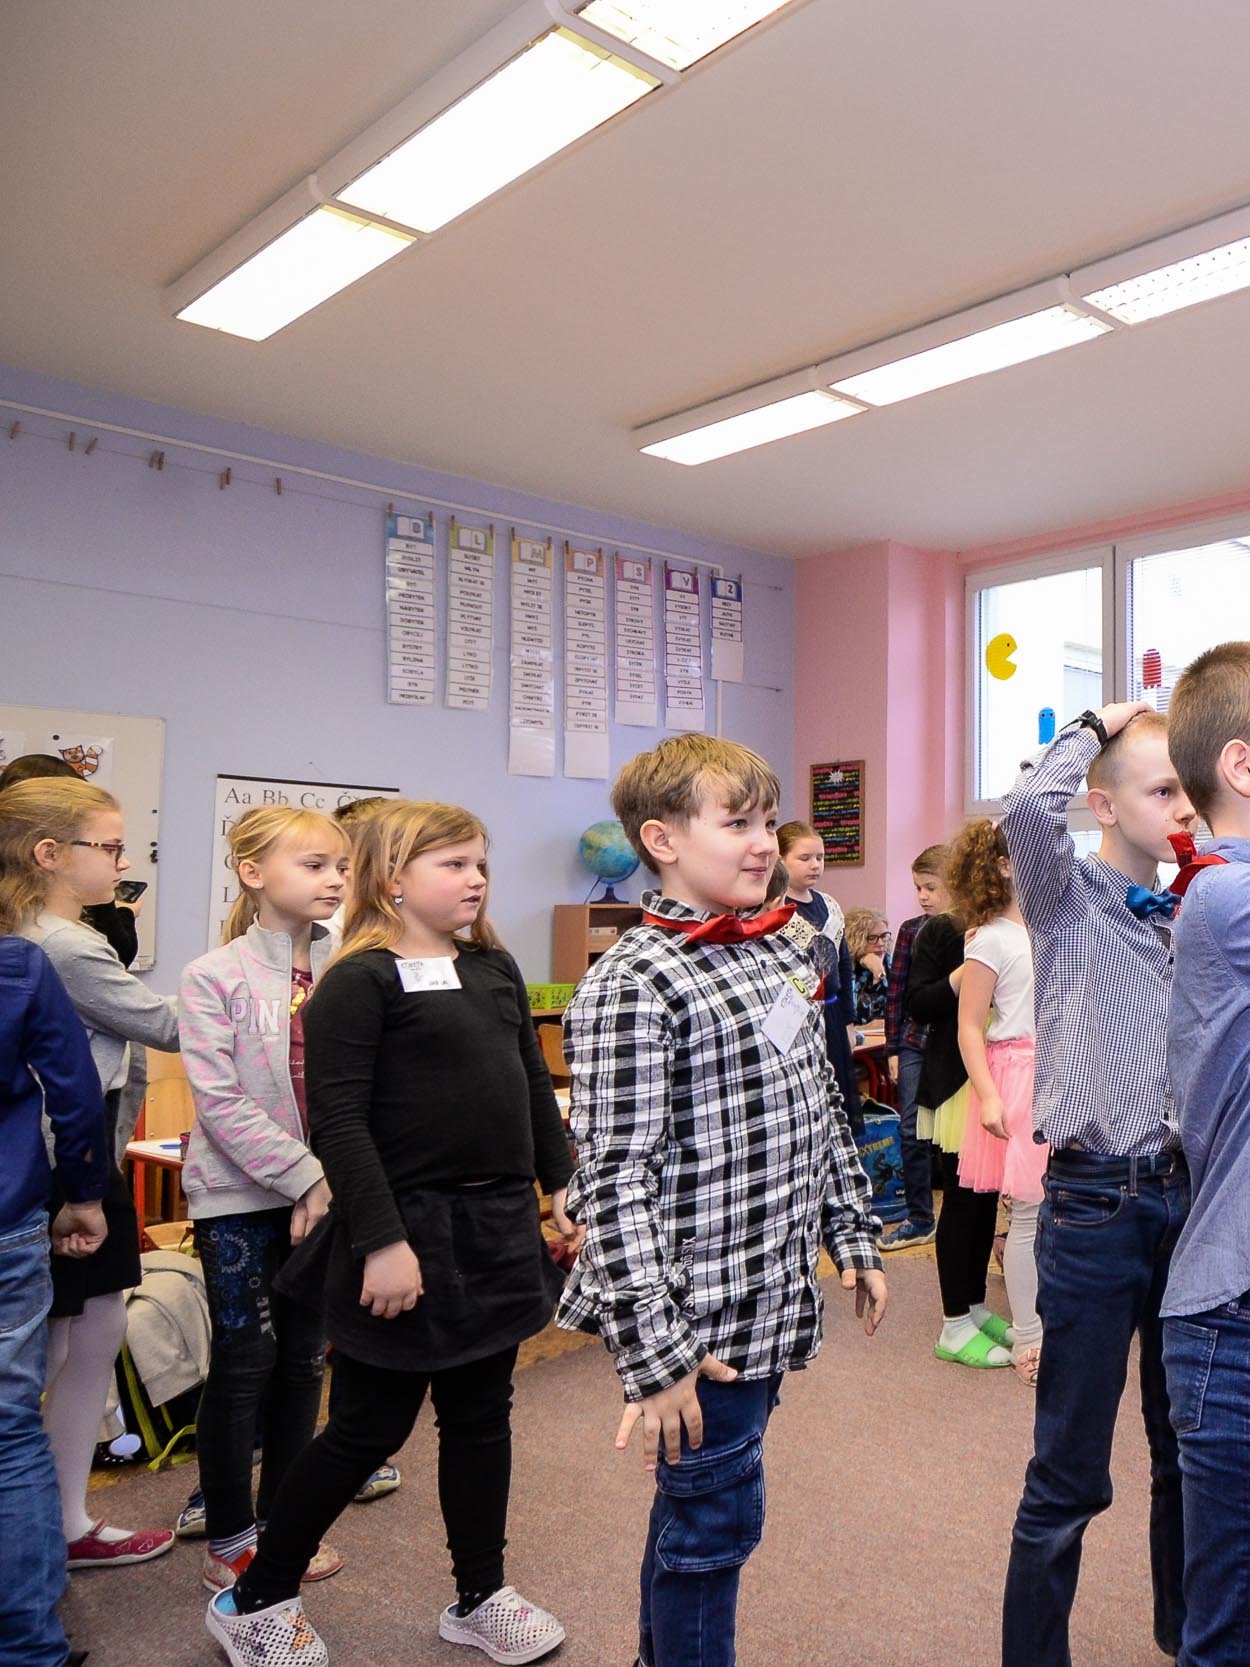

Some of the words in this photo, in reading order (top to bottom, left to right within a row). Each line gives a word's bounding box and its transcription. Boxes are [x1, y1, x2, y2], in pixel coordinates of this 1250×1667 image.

[224, 787, 251, 805] Aa
[263, 789, 289, 807] Bb
[300, 791, 325, 808] Cc
